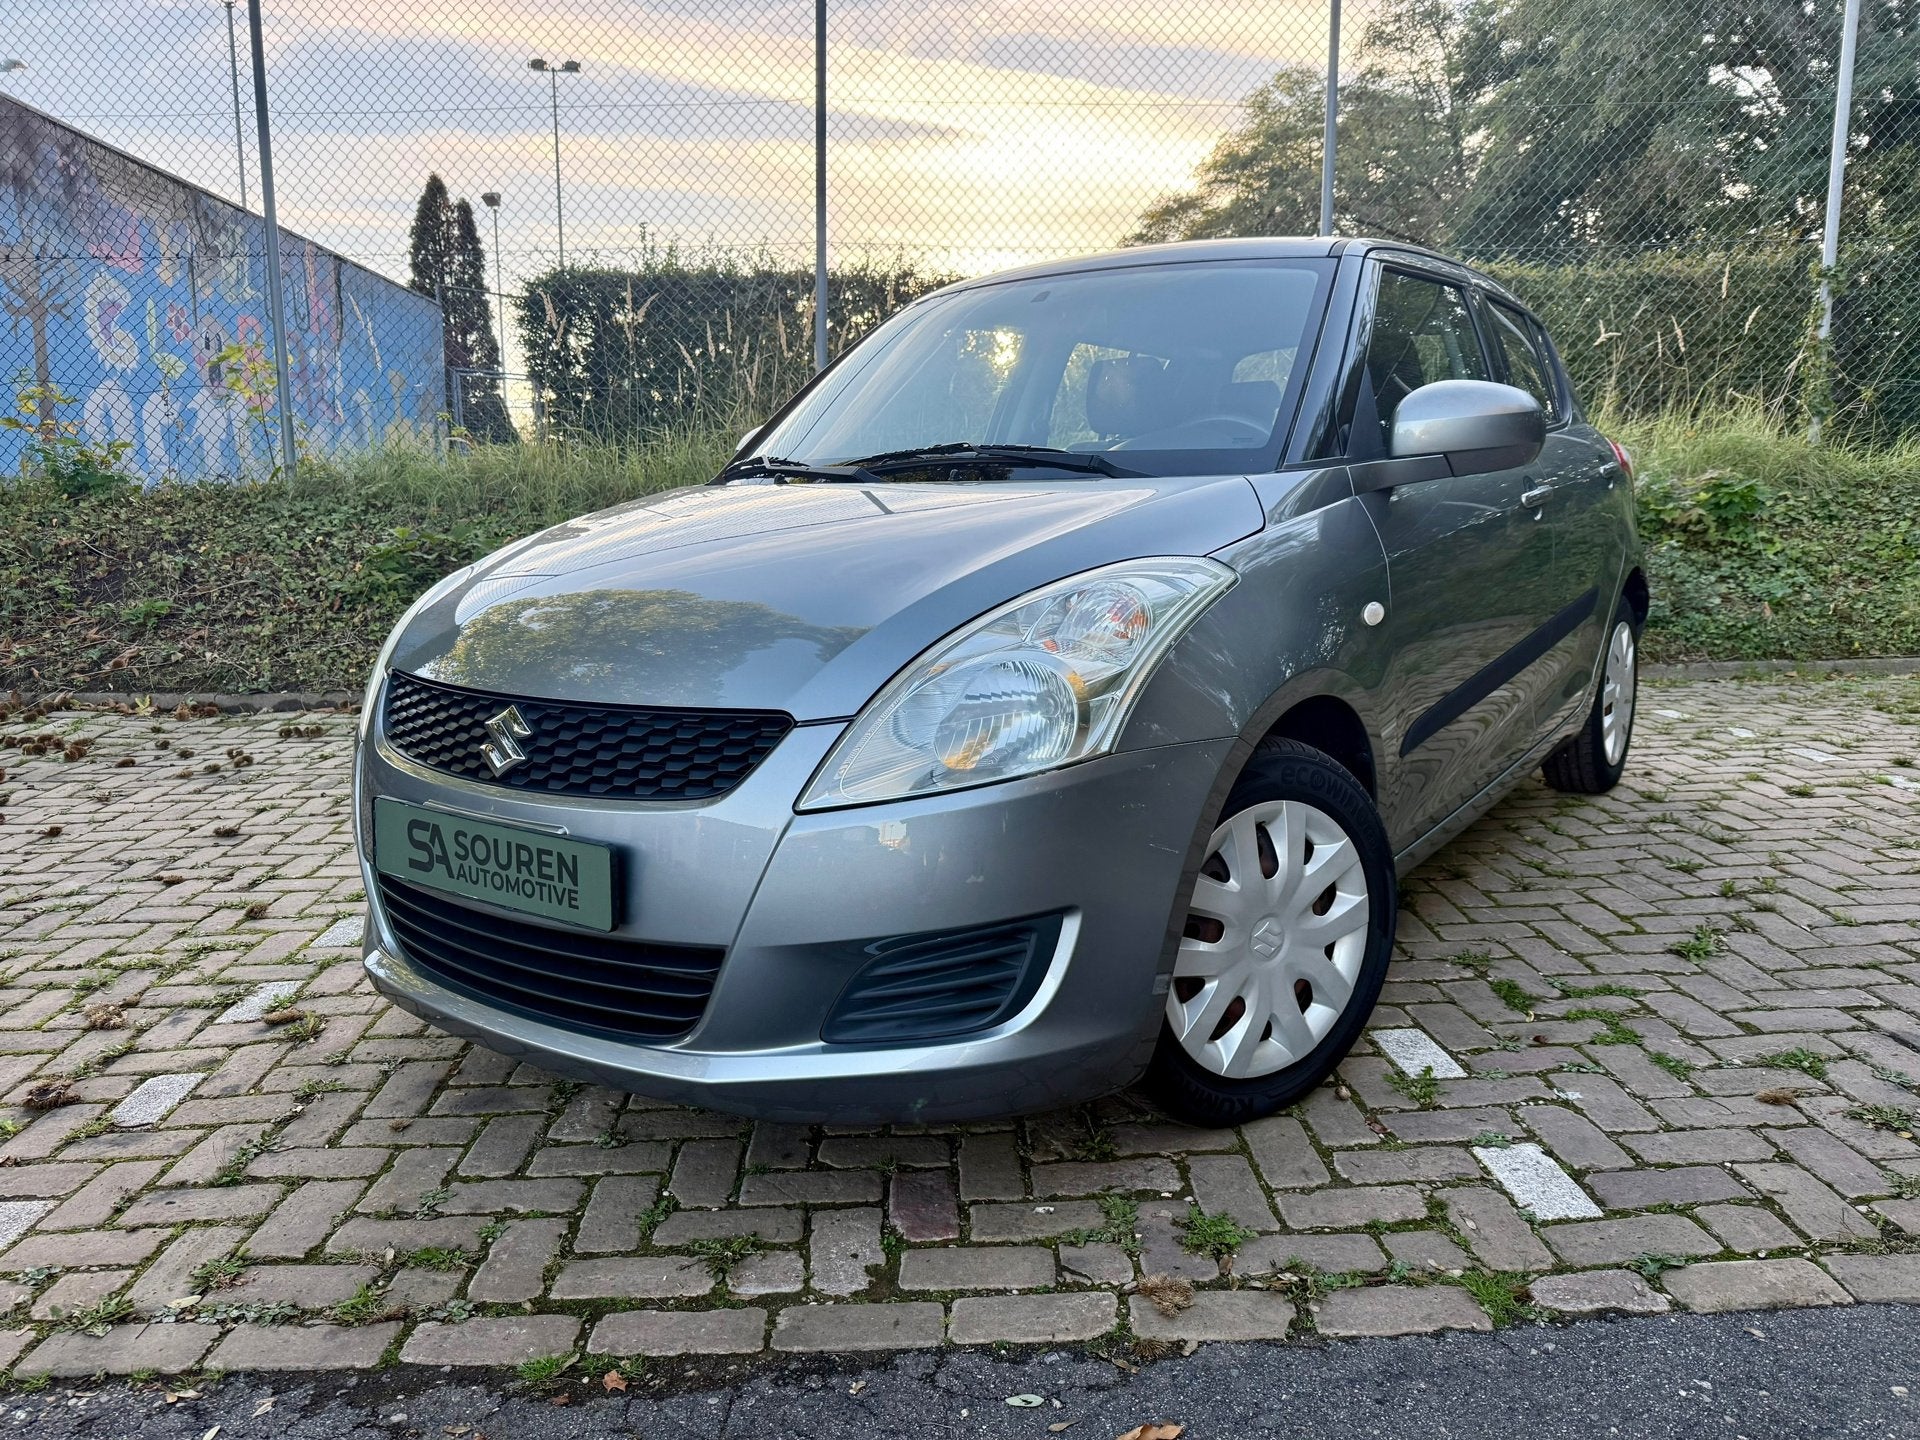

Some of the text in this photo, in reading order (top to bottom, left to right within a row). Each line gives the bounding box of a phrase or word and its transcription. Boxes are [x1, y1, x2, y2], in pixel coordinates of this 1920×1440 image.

[407, 818, 455, 879] SA
[454, 829, 579, 887] SOUREN
[456, 864, 580, 910] AUTOMOTIVE
